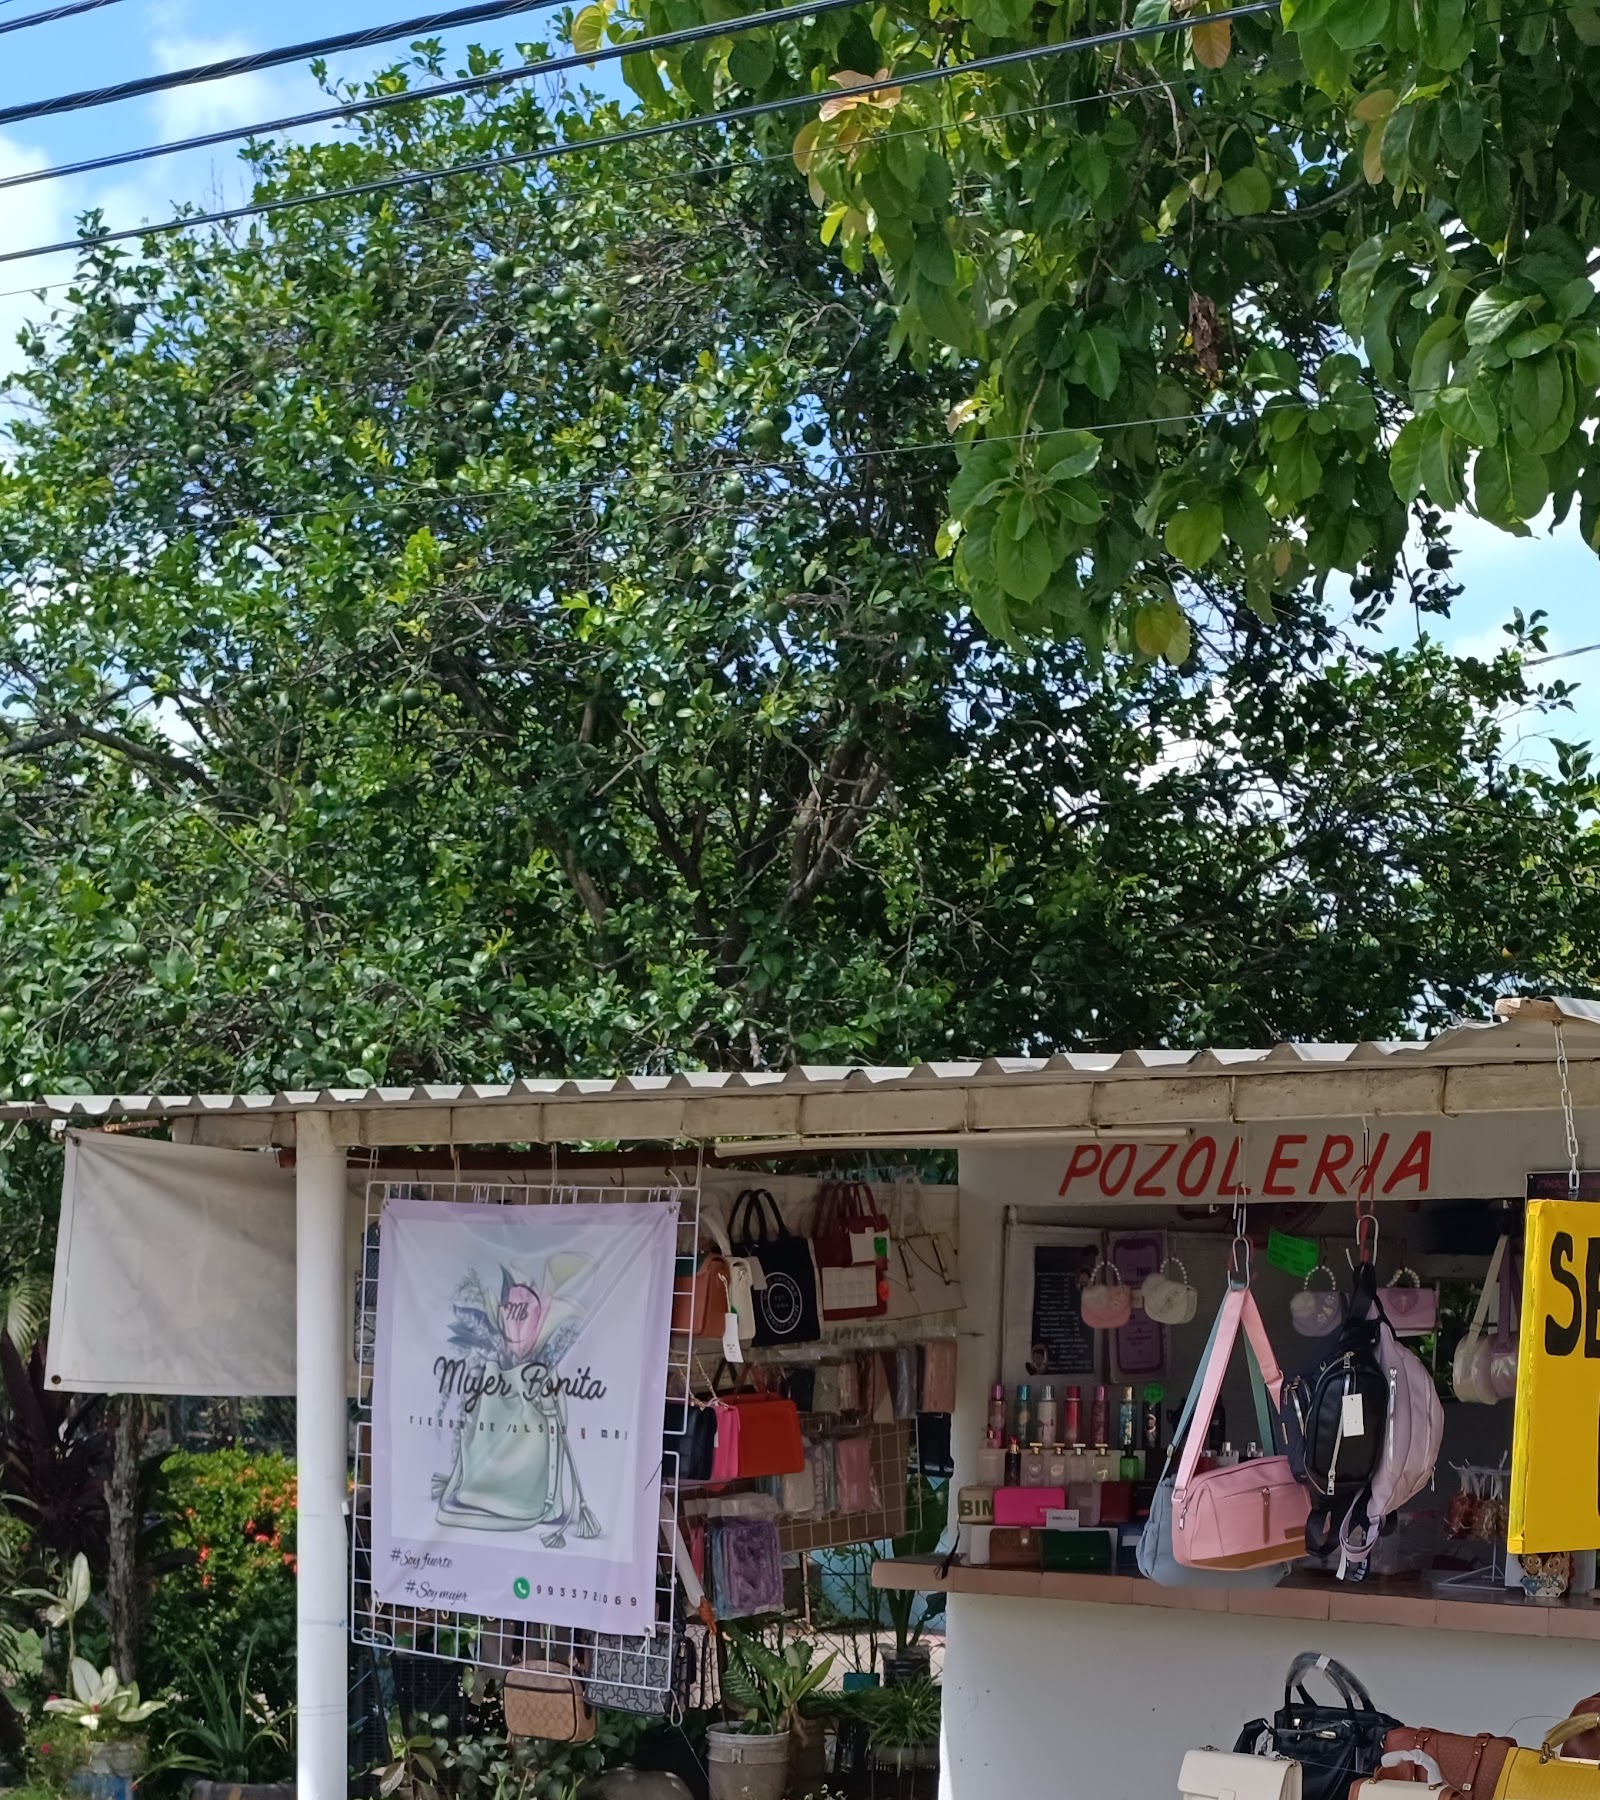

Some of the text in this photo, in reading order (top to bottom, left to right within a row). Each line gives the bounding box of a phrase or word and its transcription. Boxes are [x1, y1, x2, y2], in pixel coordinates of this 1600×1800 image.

[1059, 1130, 1432, 1198] POZOLERIA
[433, 1356, 607, 1413] Mujer Bonita
